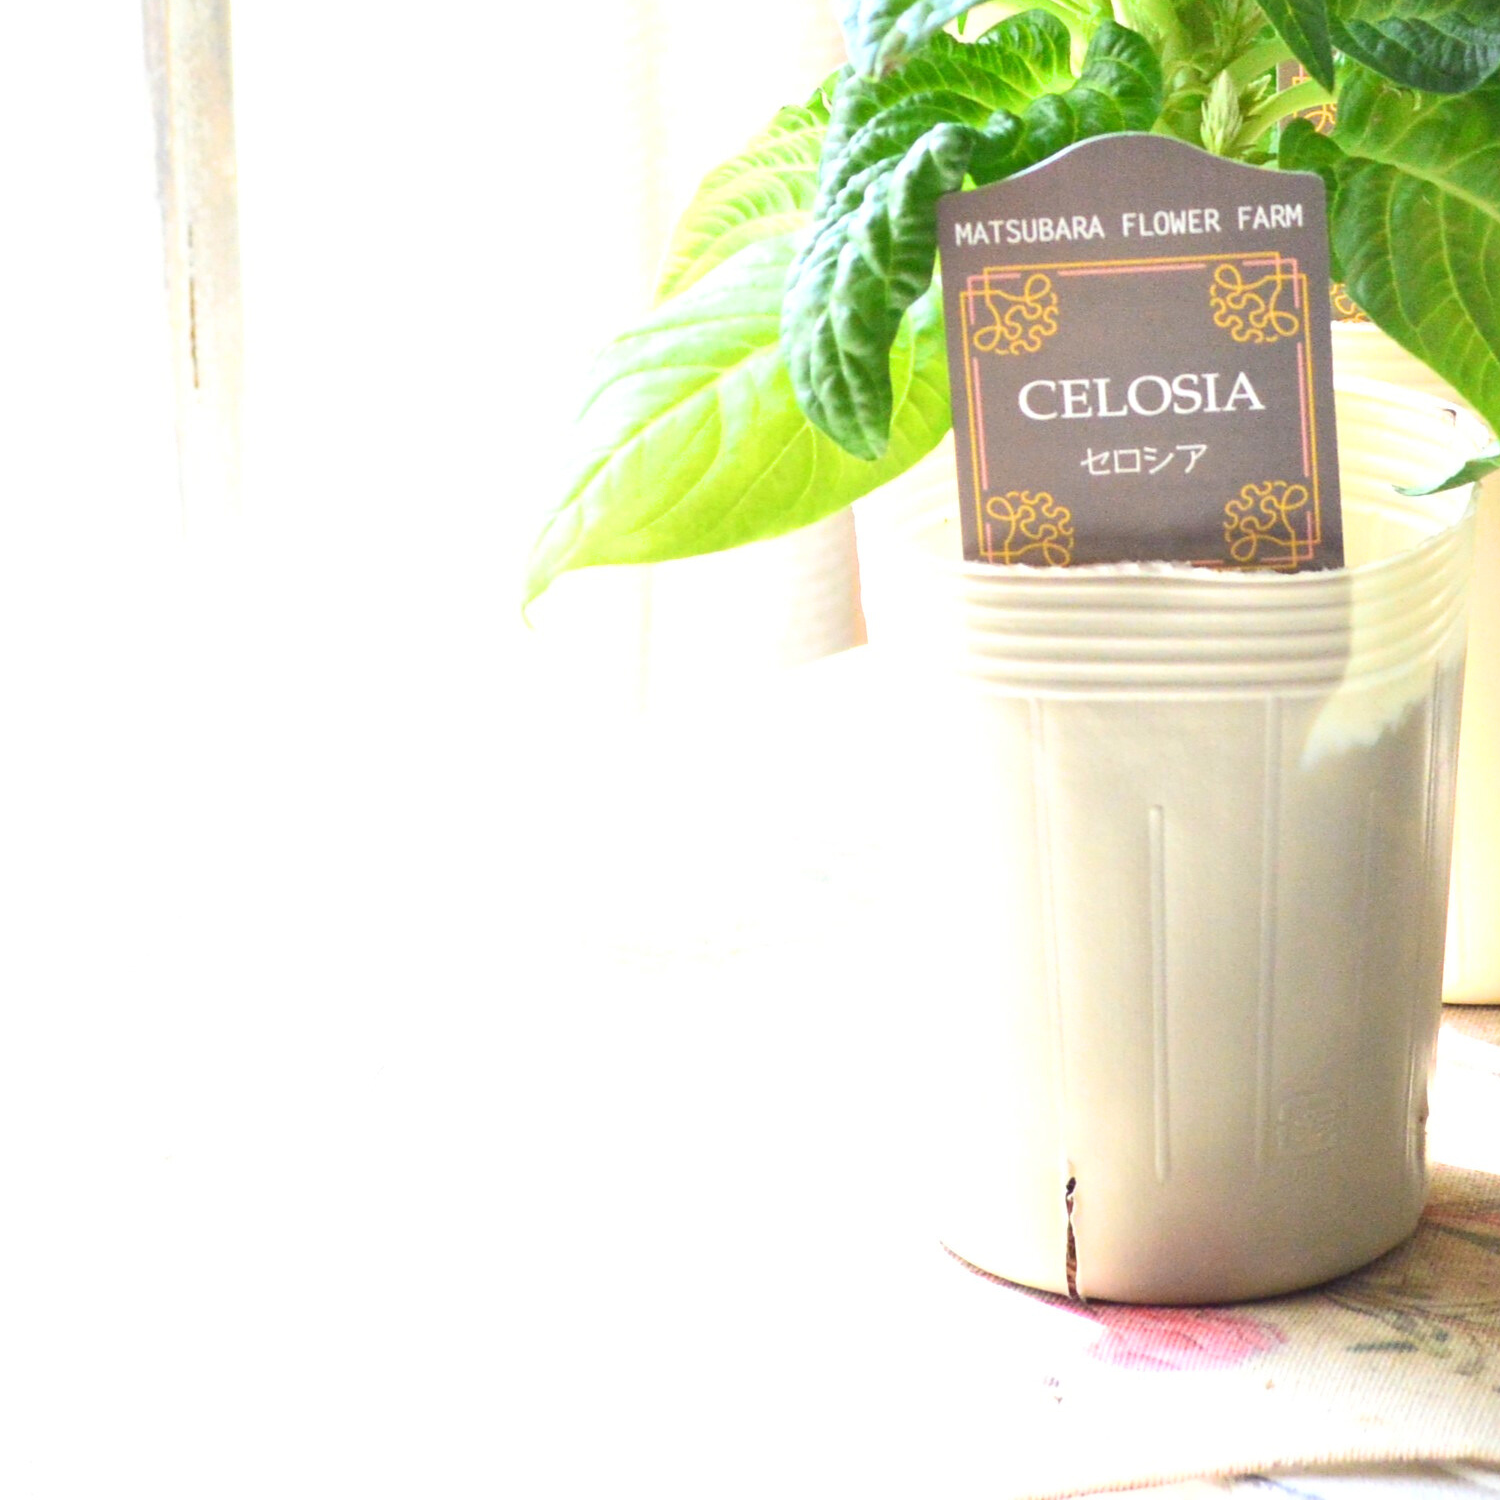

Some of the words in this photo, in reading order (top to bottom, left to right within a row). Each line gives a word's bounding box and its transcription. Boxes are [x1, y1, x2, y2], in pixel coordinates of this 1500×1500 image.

[954, 214, 1106, 246] MATSUBARA
[1121, 207, 1222, 238] FLOWER
[1237, 203, 1303, 230] FARM
[1018, 371, 1265, 420] CELOSIA
[1080, 443, 1208, 476] セロシア
